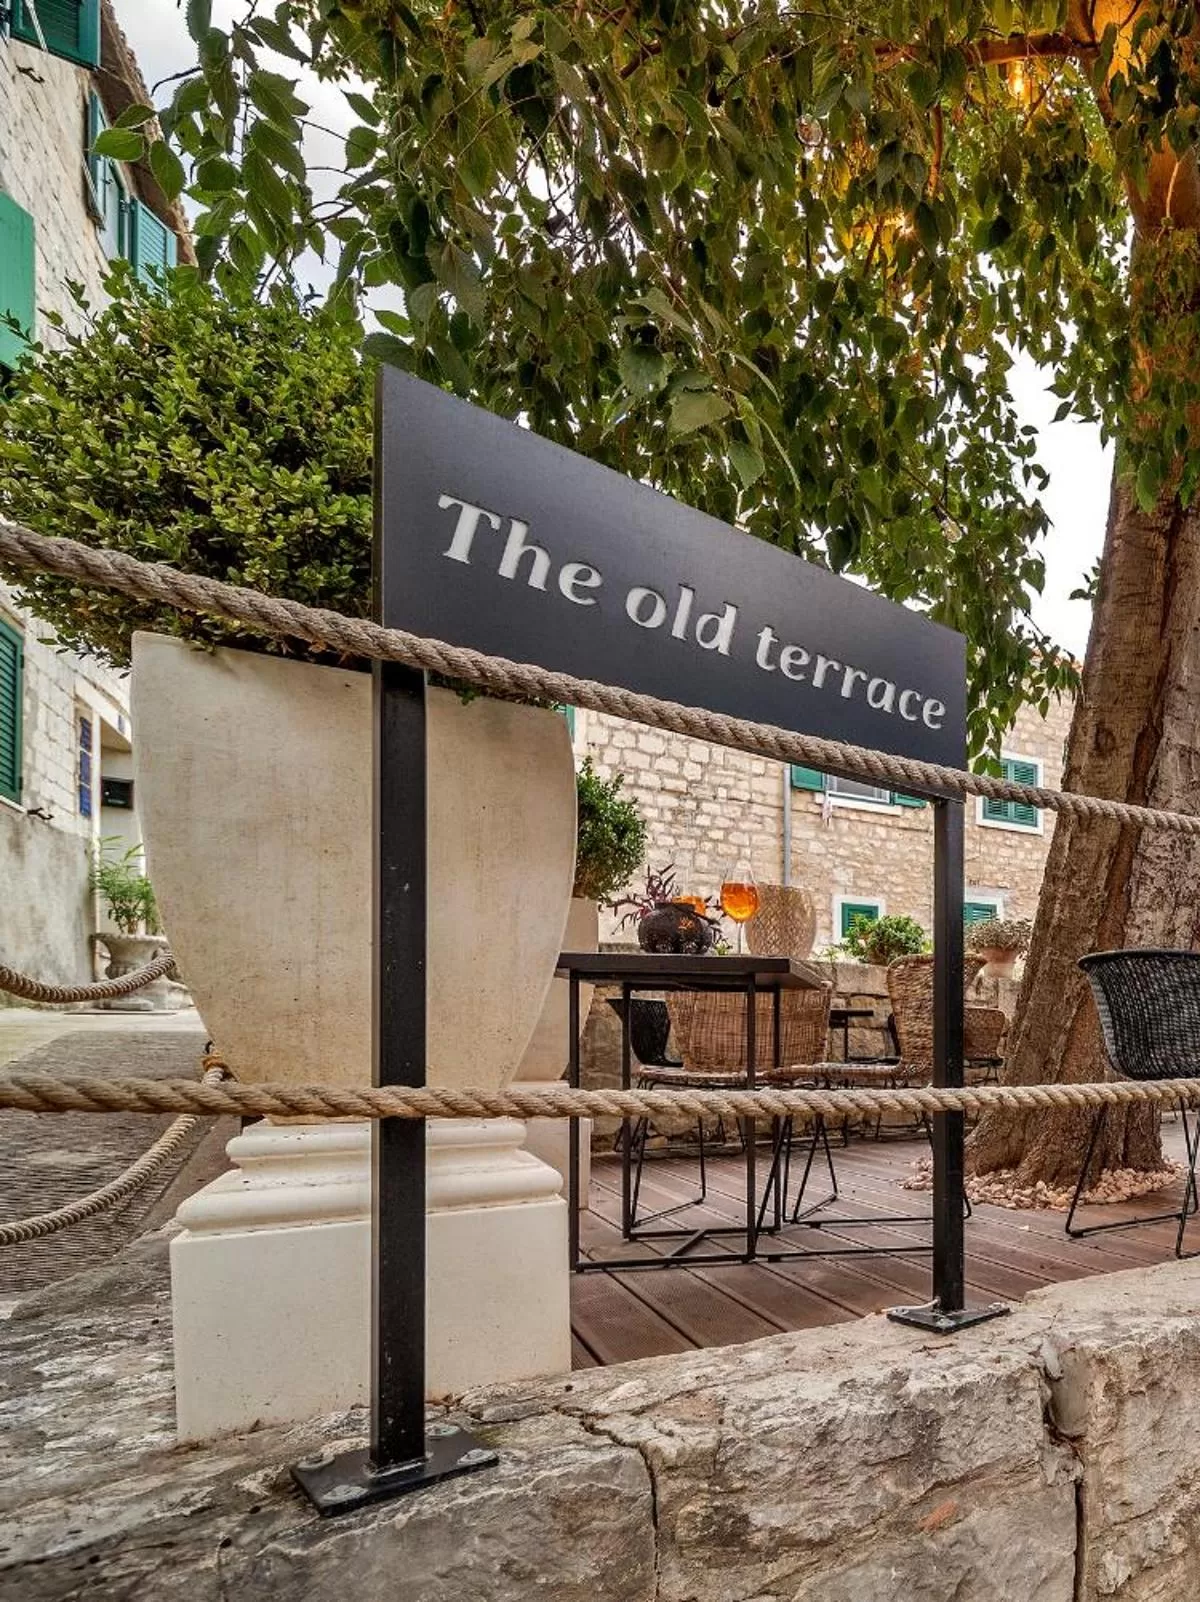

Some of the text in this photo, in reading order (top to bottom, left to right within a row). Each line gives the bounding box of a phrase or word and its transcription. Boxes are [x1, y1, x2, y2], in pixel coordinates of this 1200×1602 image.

[438, 494, 947, 730] The old terrace
